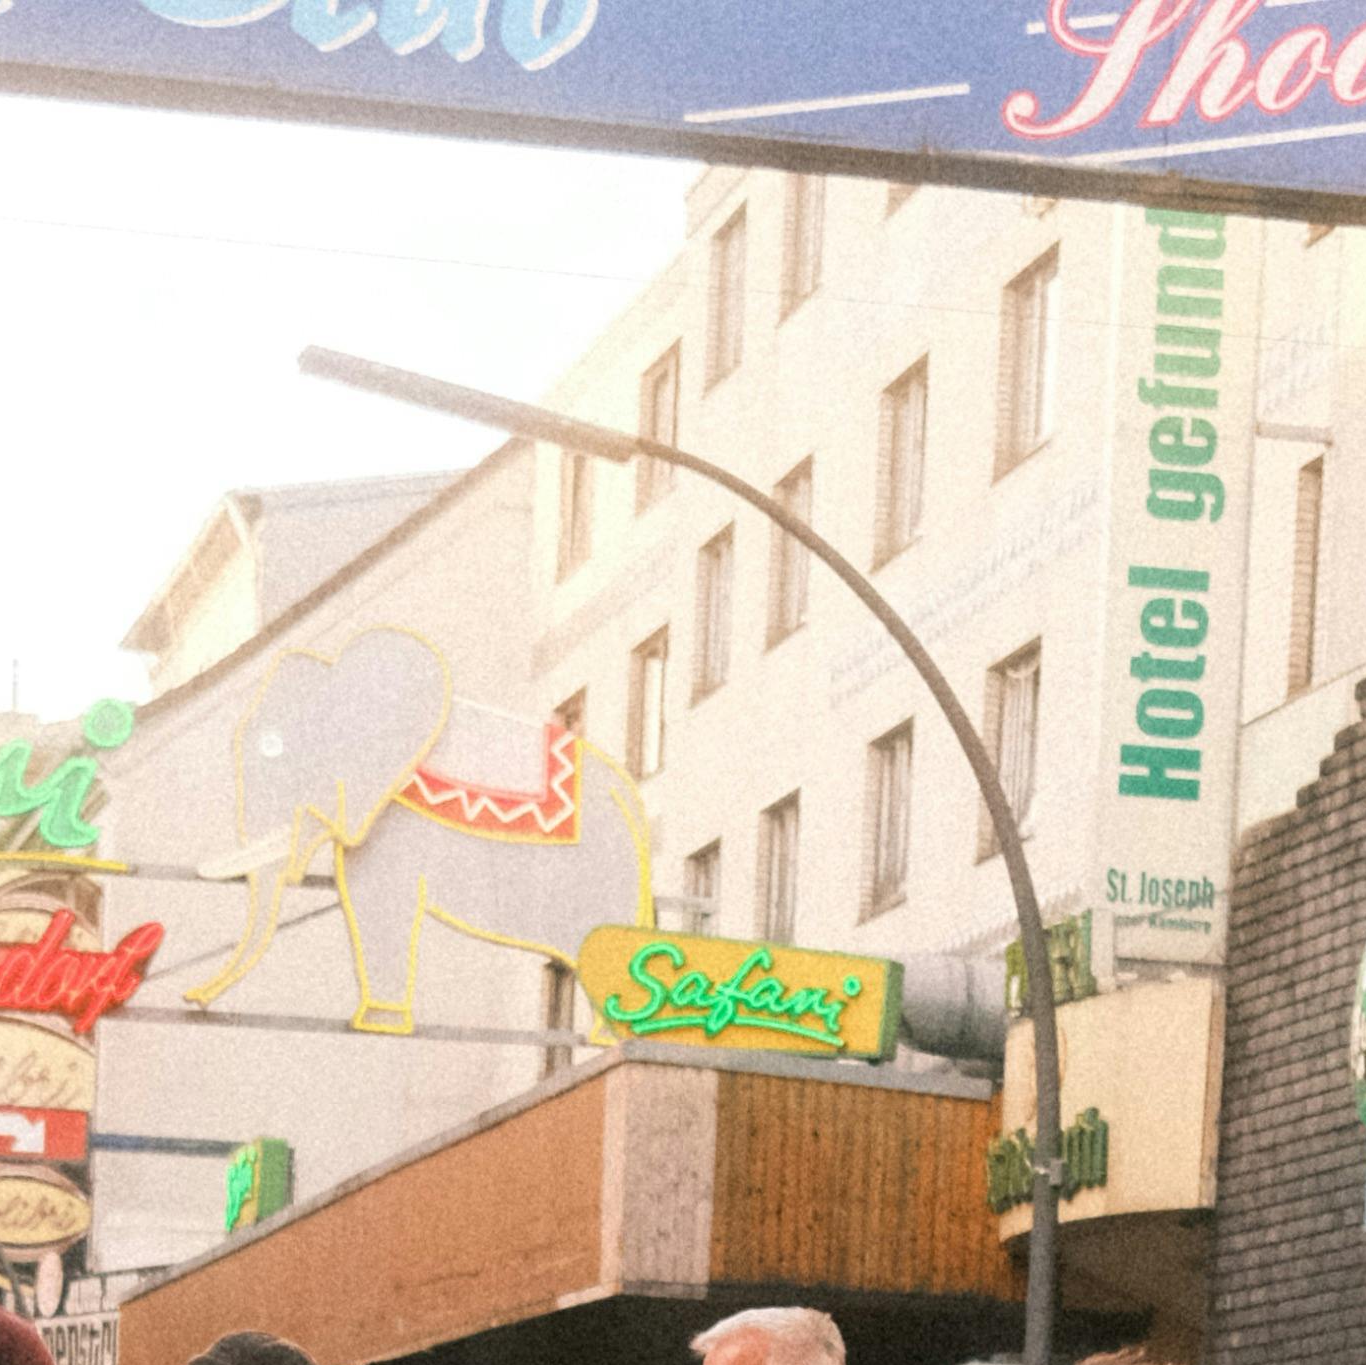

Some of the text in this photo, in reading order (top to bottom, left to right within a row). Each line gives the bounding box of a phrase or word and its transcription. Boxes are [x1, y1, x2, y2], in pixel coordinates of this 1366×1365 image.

[1118, 206, 1227, 801] Hotel gefund
[1138, 871, 1215, 912] Joseph
[604, 941, 862, 1037] Safari
